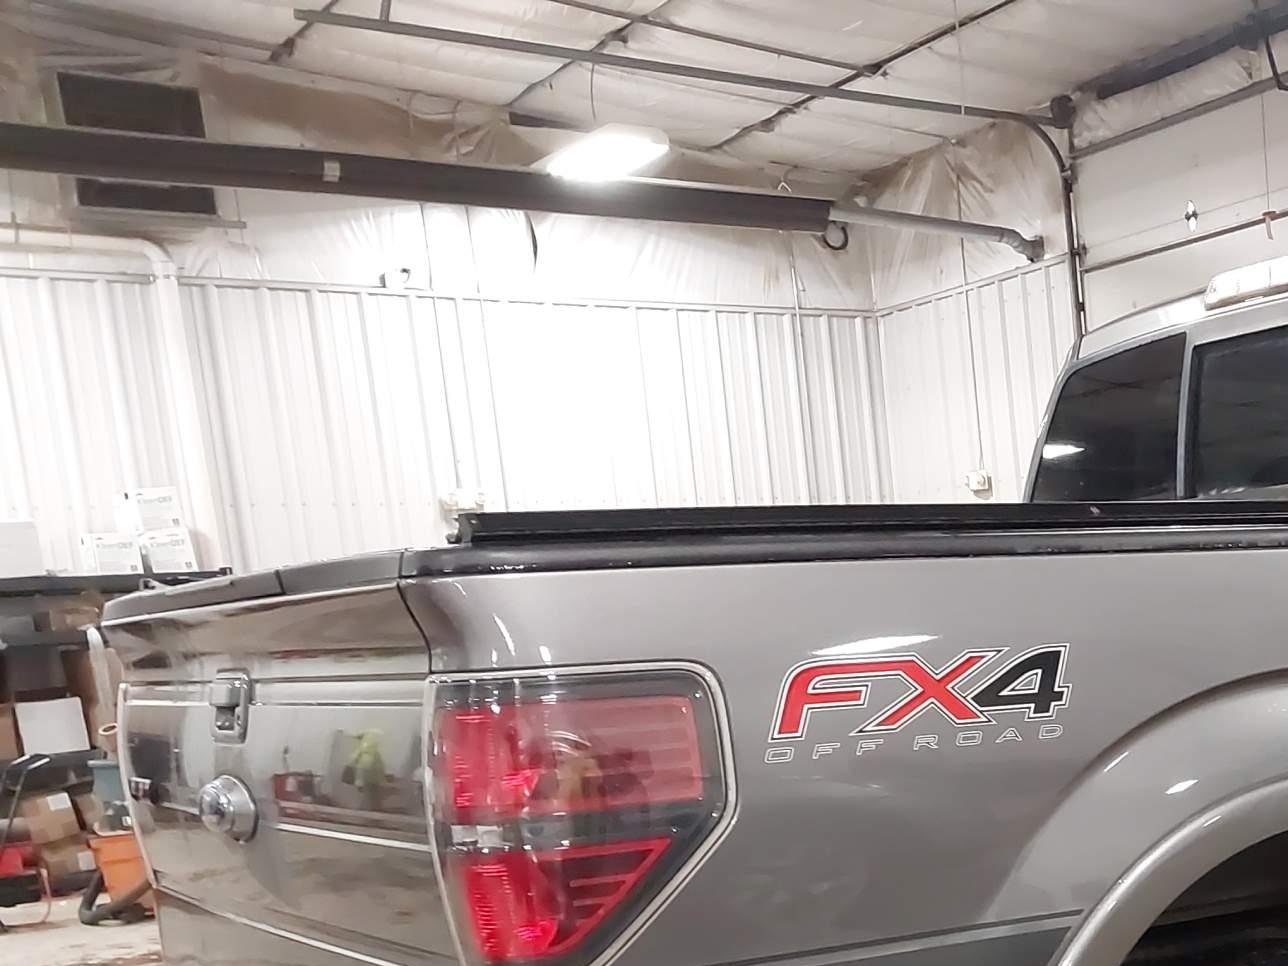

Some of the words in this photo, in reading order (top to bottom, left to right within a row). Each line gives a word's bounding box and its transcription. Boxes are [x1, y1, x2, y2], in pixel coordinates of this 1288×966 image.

[768, 643, 1072, 743] FX4
[764, 738, 884, 764] OFF
[913, 724, 1064, 750] ROAD
